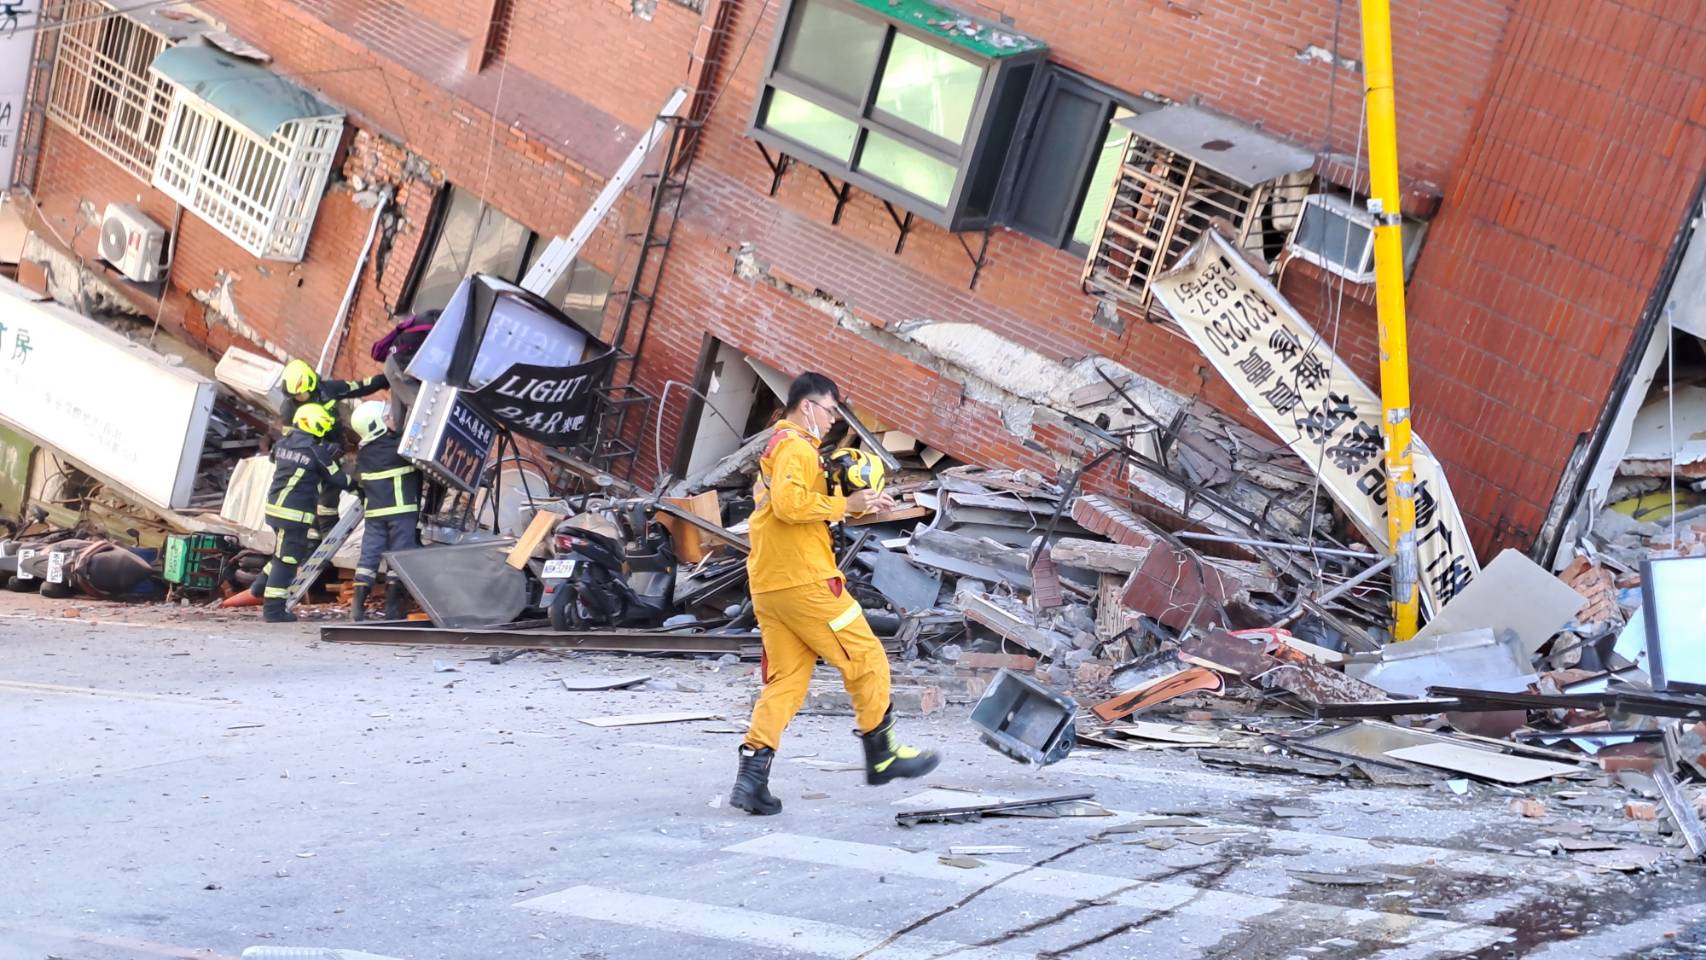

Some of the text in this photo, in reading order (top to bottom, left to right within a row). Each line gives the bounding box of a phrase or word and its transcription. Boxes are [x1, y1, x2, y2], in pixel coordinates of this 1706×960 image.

[1204, 289, 1277, 357] 8321250
[1268, 323, 1330, 391] 維修
[496, 374, 588, 404] LIGHT
[1233, 346, 1301, 417] 買賣
[493, 406, 564, 435] BAR
